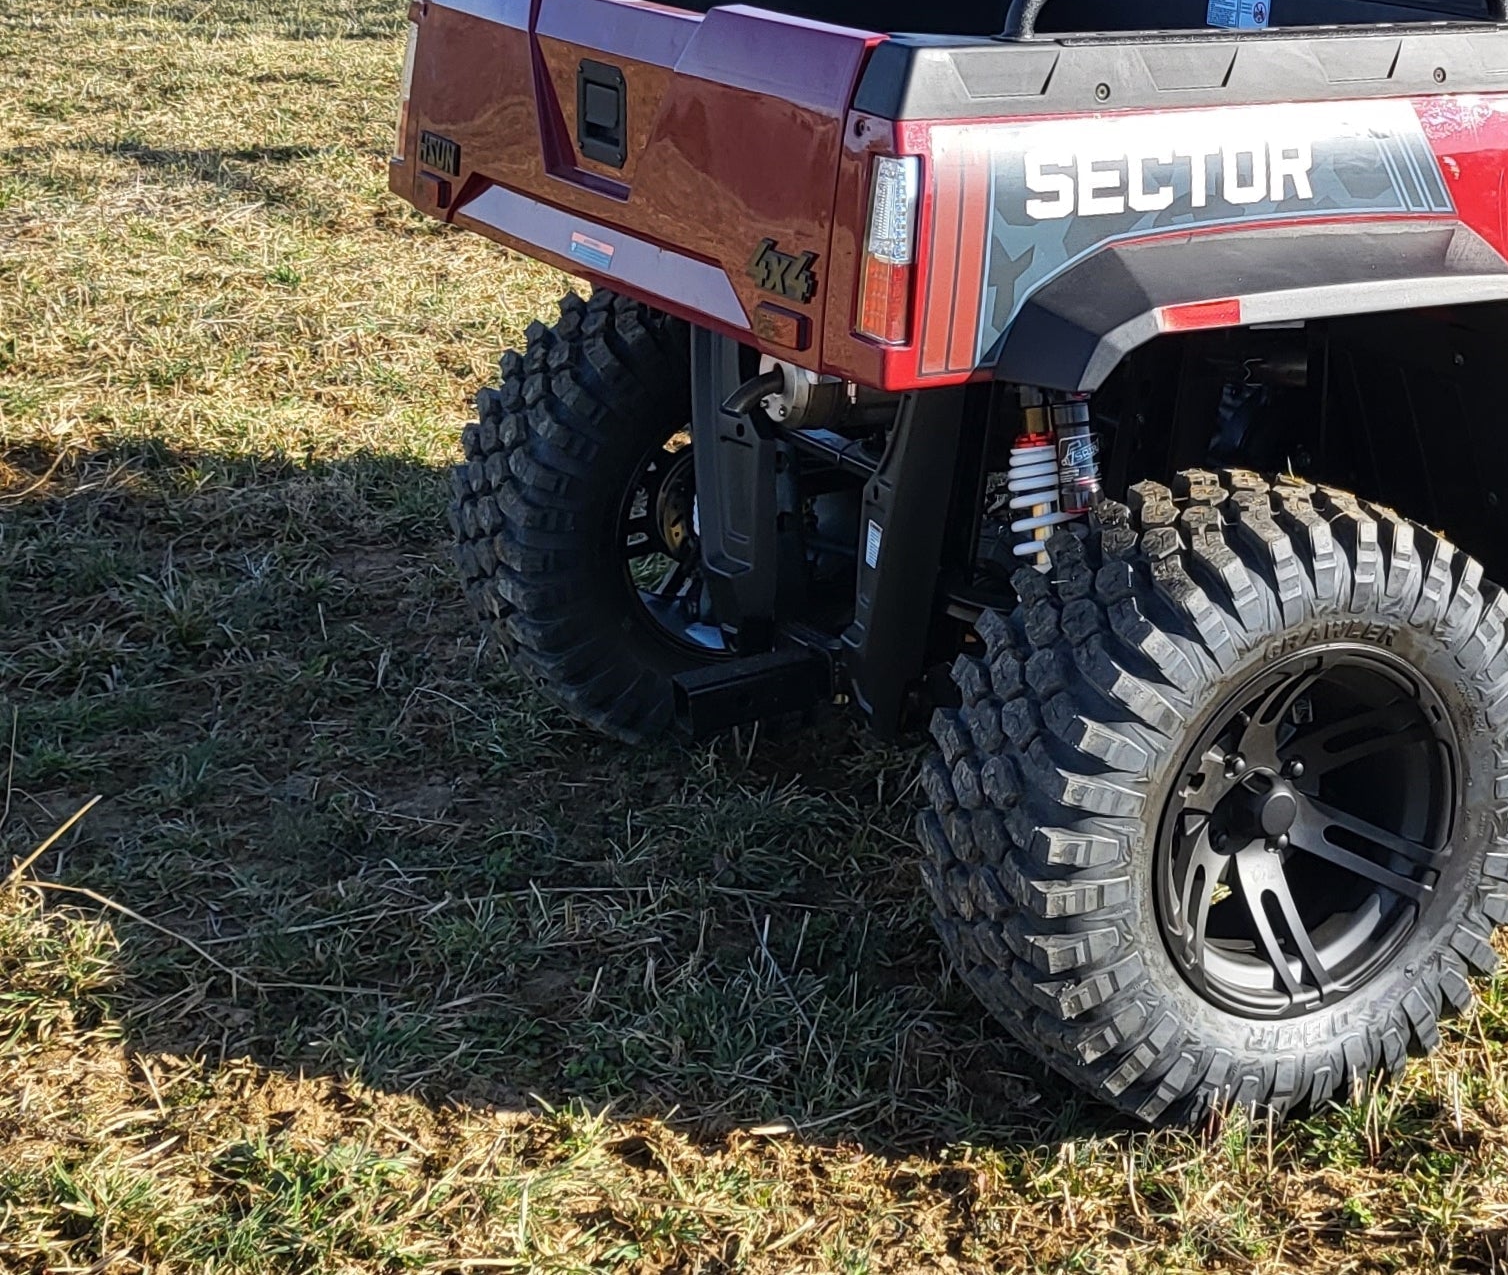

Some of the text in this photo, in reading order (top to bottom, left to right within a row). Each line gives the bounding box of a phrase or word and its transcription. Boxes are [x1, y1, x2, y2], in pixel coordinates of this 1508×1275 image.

[1024, 137, 1314, 220] SECTOR
[746, 237, 820, 304] 4x4
[1264, 618, 1400, 663] CRAWLER
